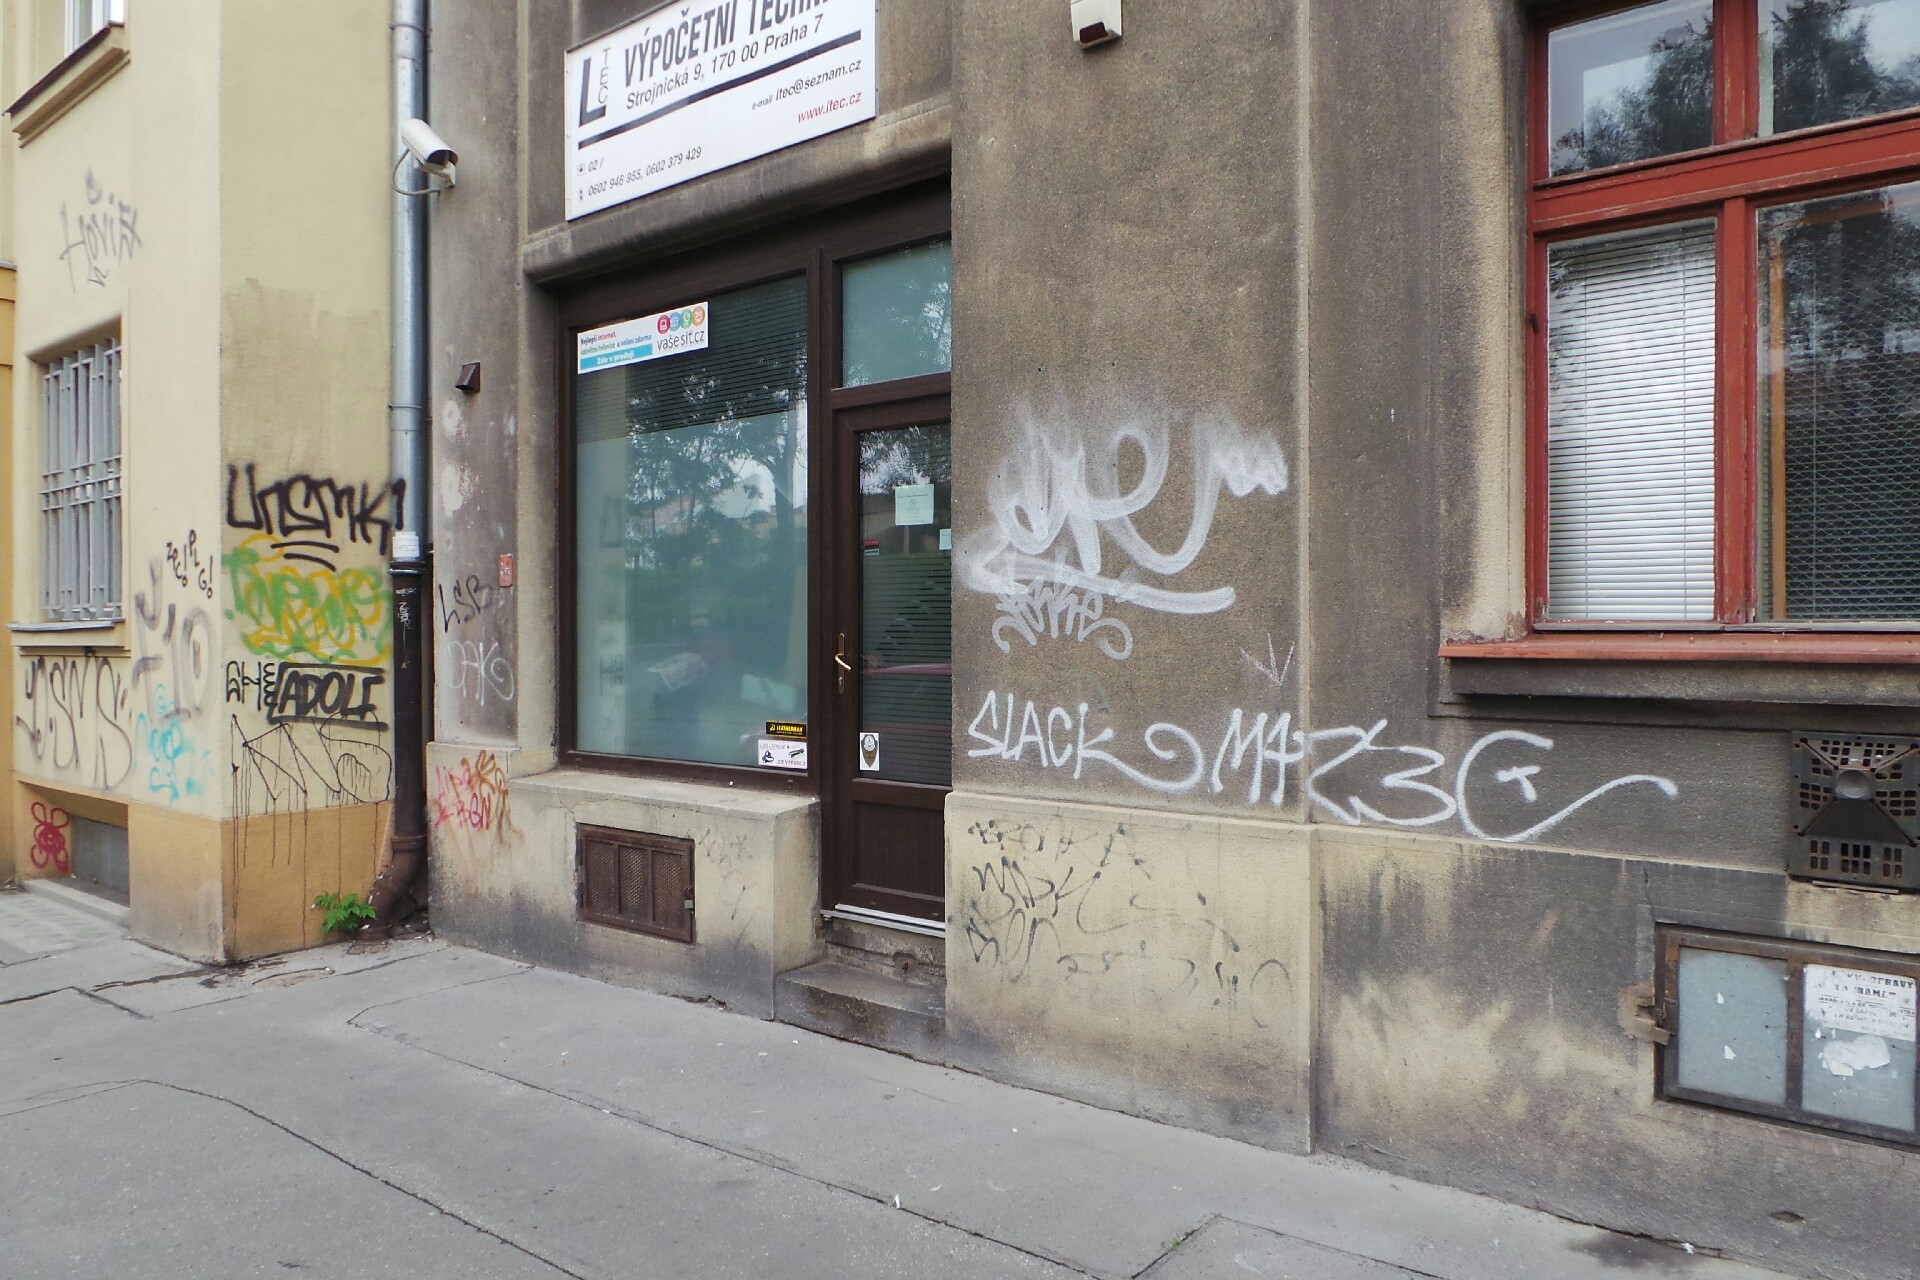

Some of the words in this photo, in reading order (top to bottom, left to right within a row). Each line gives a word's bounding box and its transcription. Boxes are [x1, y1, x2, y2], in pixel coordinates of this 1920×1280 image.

[626, 64, 689, 110] Strojnická
[693, 62, 704, 81] 9,
[712, 50, 735, 73] 170
[741, 41, 758, 63] 00
[764, 24, 807, 53] Praha
[814, 13, 823, 33] 7
[588, 181, 607, 196] 0602
[646, 159, 665, 176] 0602
[667, 153, 683, 168] 379
[685, 146, 702, 161] 429
